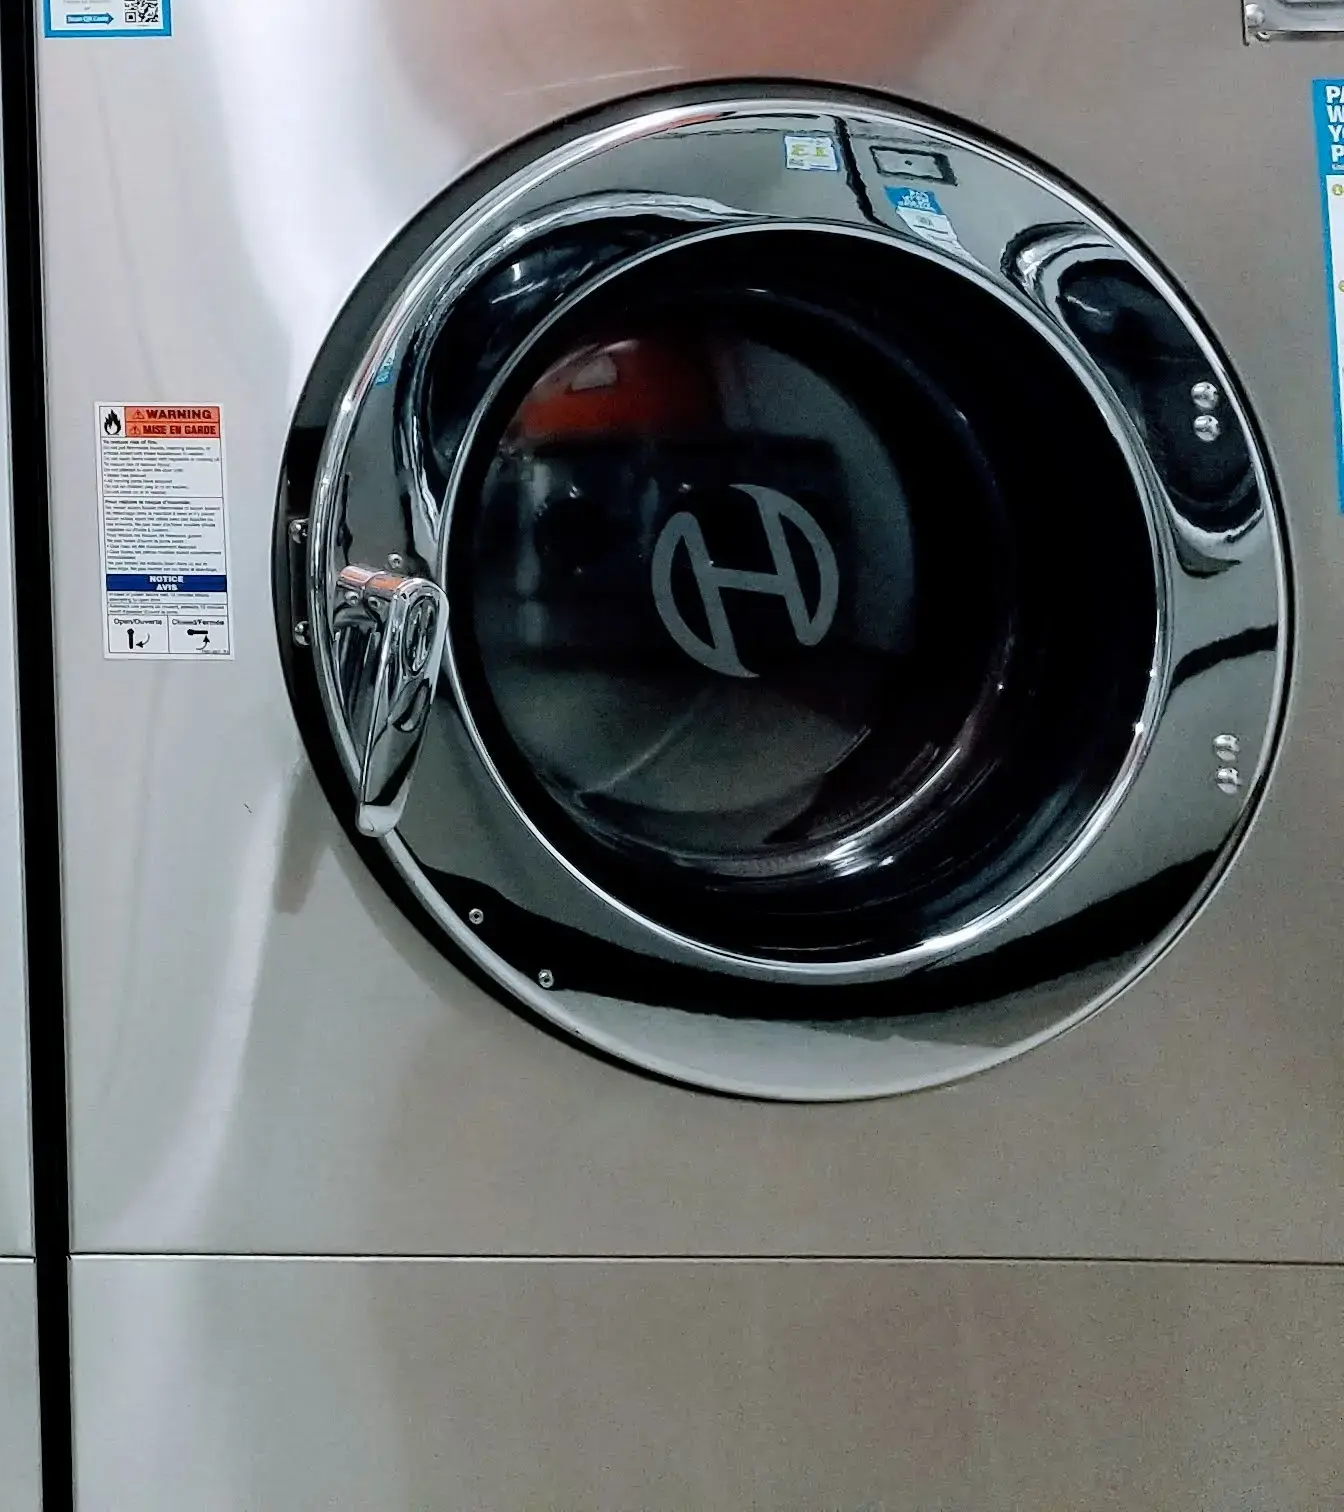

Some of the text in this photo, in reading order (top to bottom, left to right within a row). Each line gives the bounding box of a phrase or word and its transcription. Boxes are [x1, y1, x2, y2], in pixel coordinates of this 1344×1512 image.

[146, 409, 212, 420] WARNING
[143, 425, 167, 435] MISE
[184, 425, 216, 435] GARDE
[149, 575, 184, 583] NOTICE
[156, 583, 178, 591] AVIS
